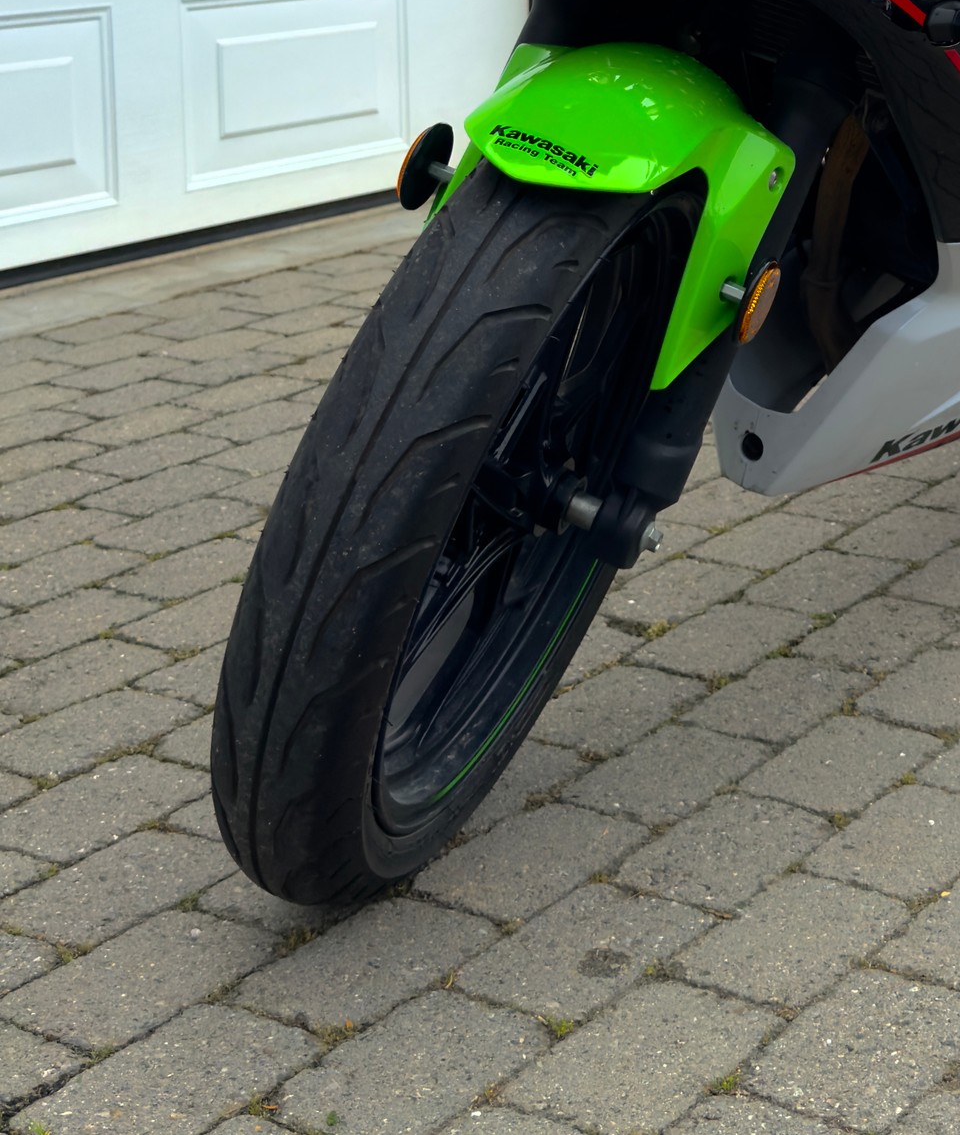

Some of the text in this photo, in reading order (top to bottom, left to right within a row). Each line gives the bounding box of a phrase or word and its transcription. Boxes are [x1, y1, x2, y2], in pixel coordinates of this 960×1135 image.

[490, 125, 599, 177] Kawasaki
[494, 138, 577, 177] Racing Team
